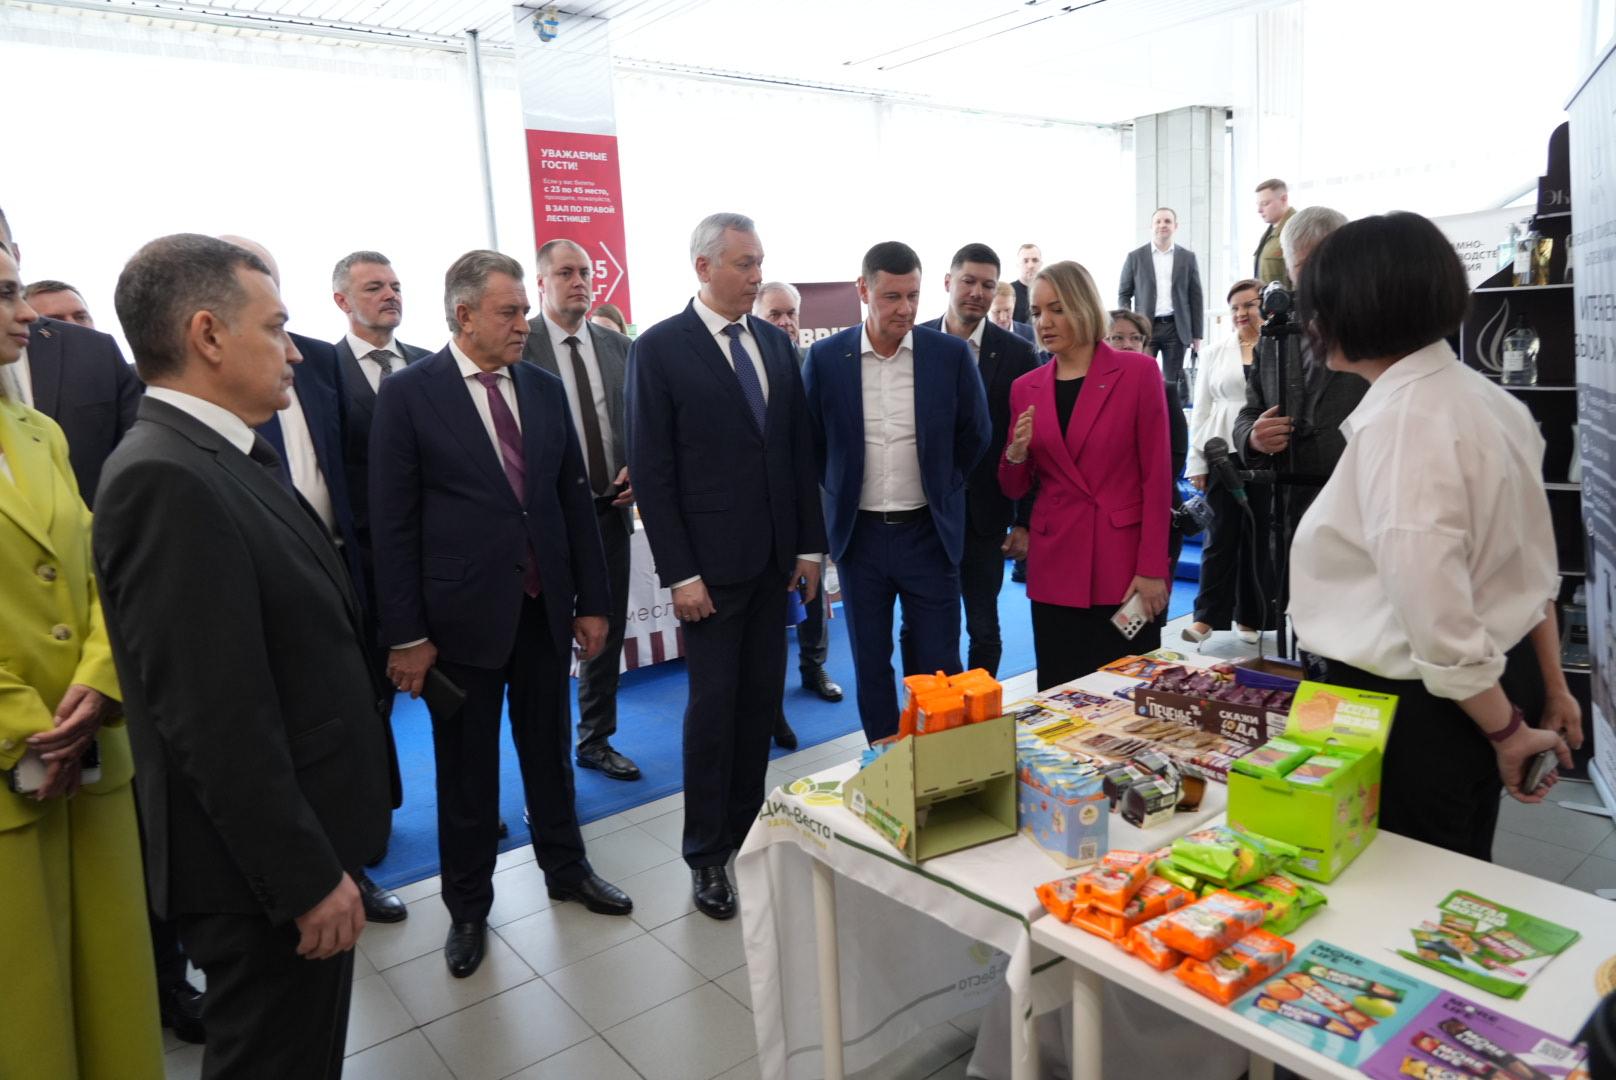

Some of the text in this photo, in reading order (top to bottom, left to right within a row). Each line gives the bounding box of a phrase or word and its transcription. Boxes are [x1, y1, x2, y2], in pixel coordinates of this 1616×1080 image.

[541, 148, 608, 161] УВАЖАЕМЫЕ
[541, 160, 578, 170] ГОСТИ!
[545, 204, 551, 212] В
[570, 205, 582, 213] ПО
[583, 205, 616, 214] ПРАВОЙ
[1149, 702, 1193, 726] ПЕЧЕНЬЕ
[1219, 710, 1260, 725] СКАЖИ
